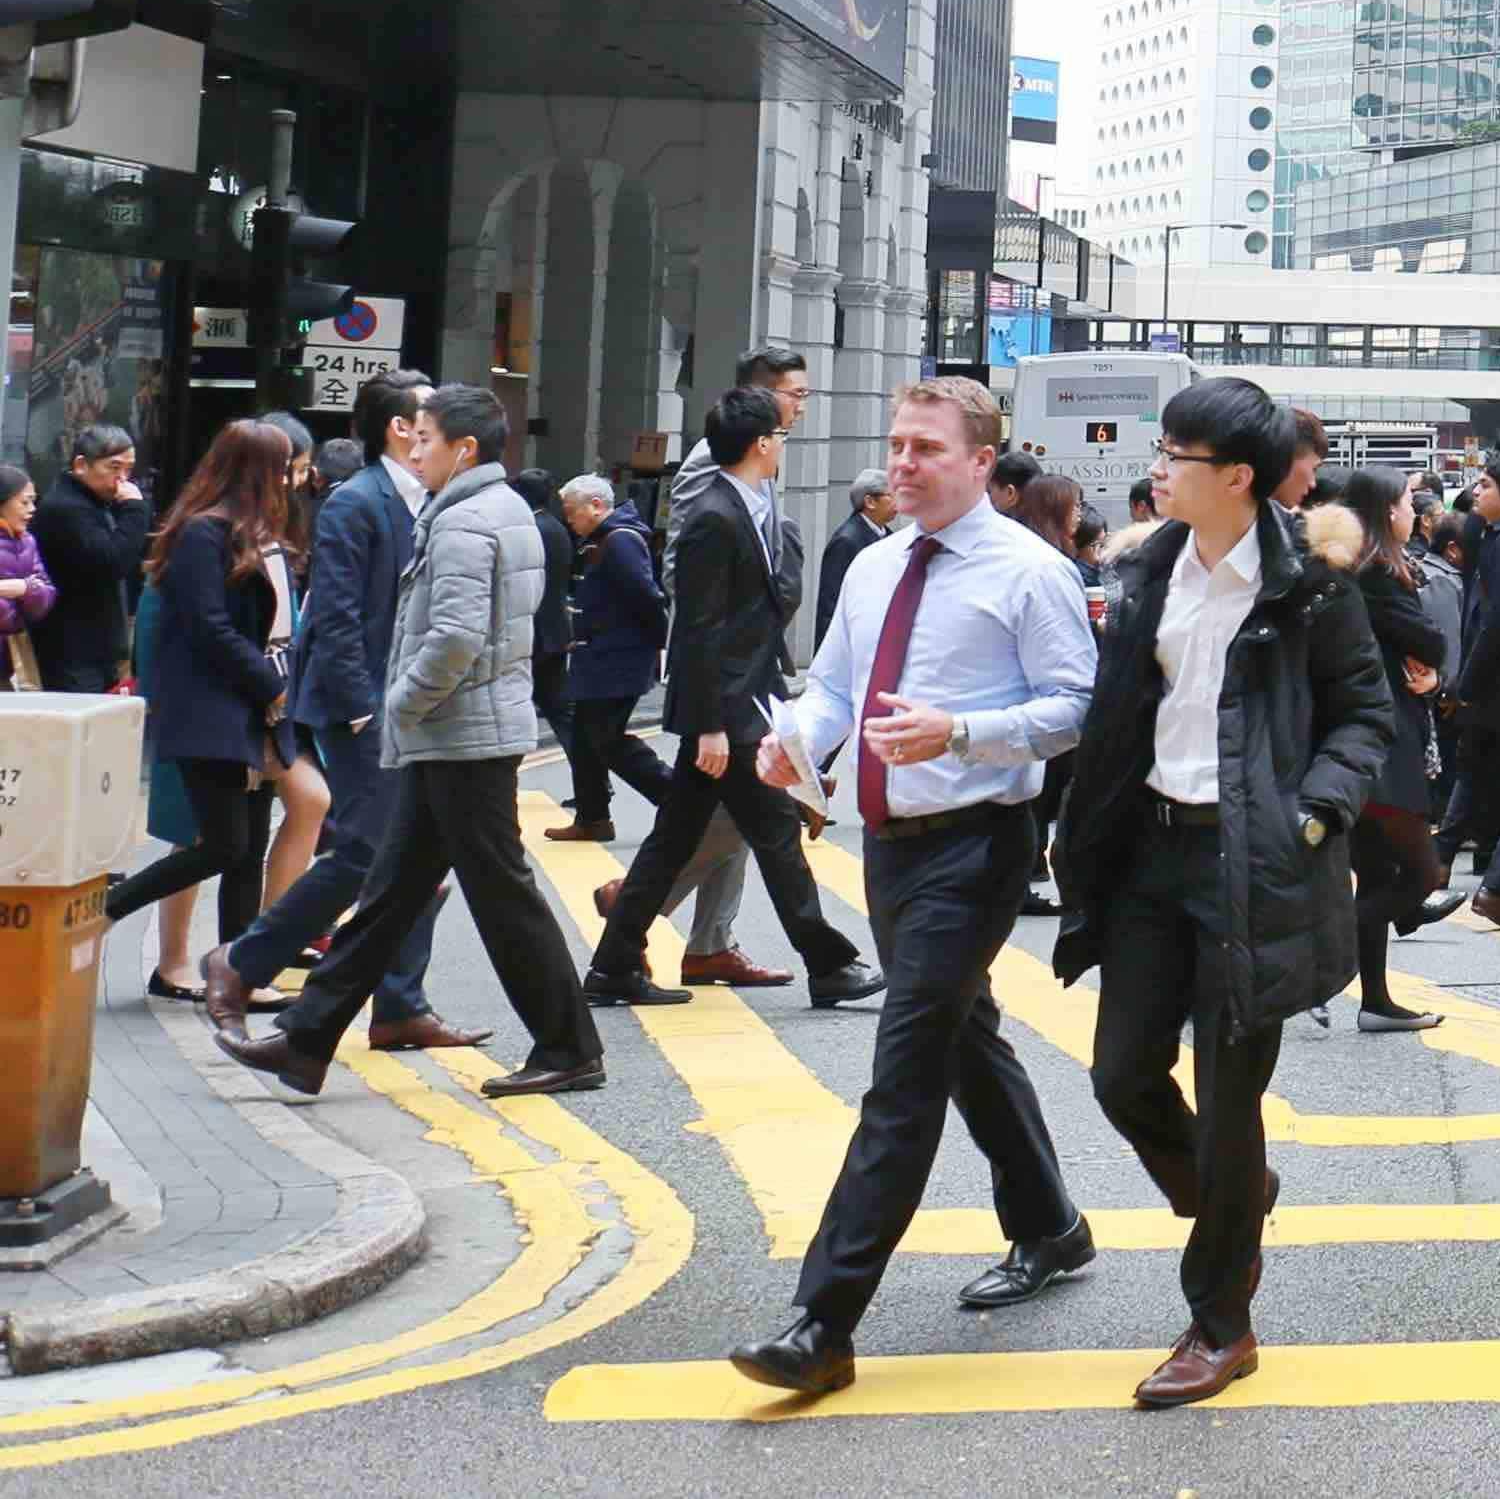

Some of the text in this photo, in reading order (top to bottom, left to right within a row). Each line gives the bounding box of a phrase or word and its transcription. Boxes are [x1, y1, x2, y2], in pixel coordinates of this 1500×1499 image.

[314, 353, 390, 374] 24 hrs
[1096, 423, 1107, 442] 6
